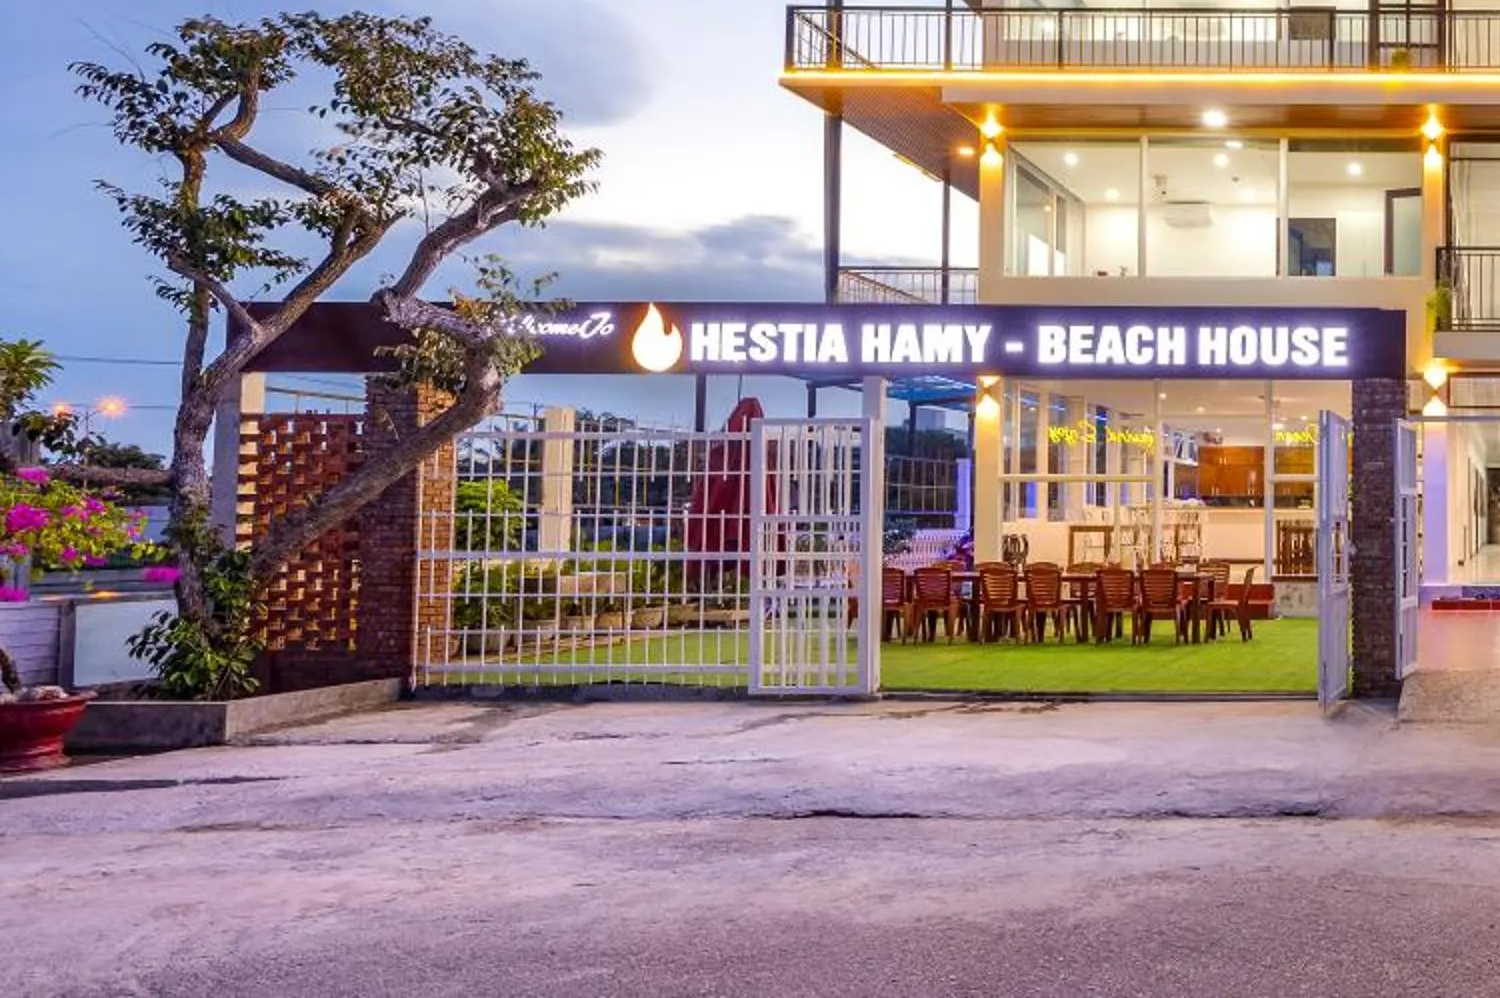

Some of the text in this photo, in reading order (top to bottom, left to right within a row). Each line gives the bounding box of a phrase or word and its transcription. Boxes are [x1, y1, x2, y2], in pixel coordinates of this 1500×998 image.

[691, 322, 1348, 366] HESTIA HAMY - BEACH HOUSE
